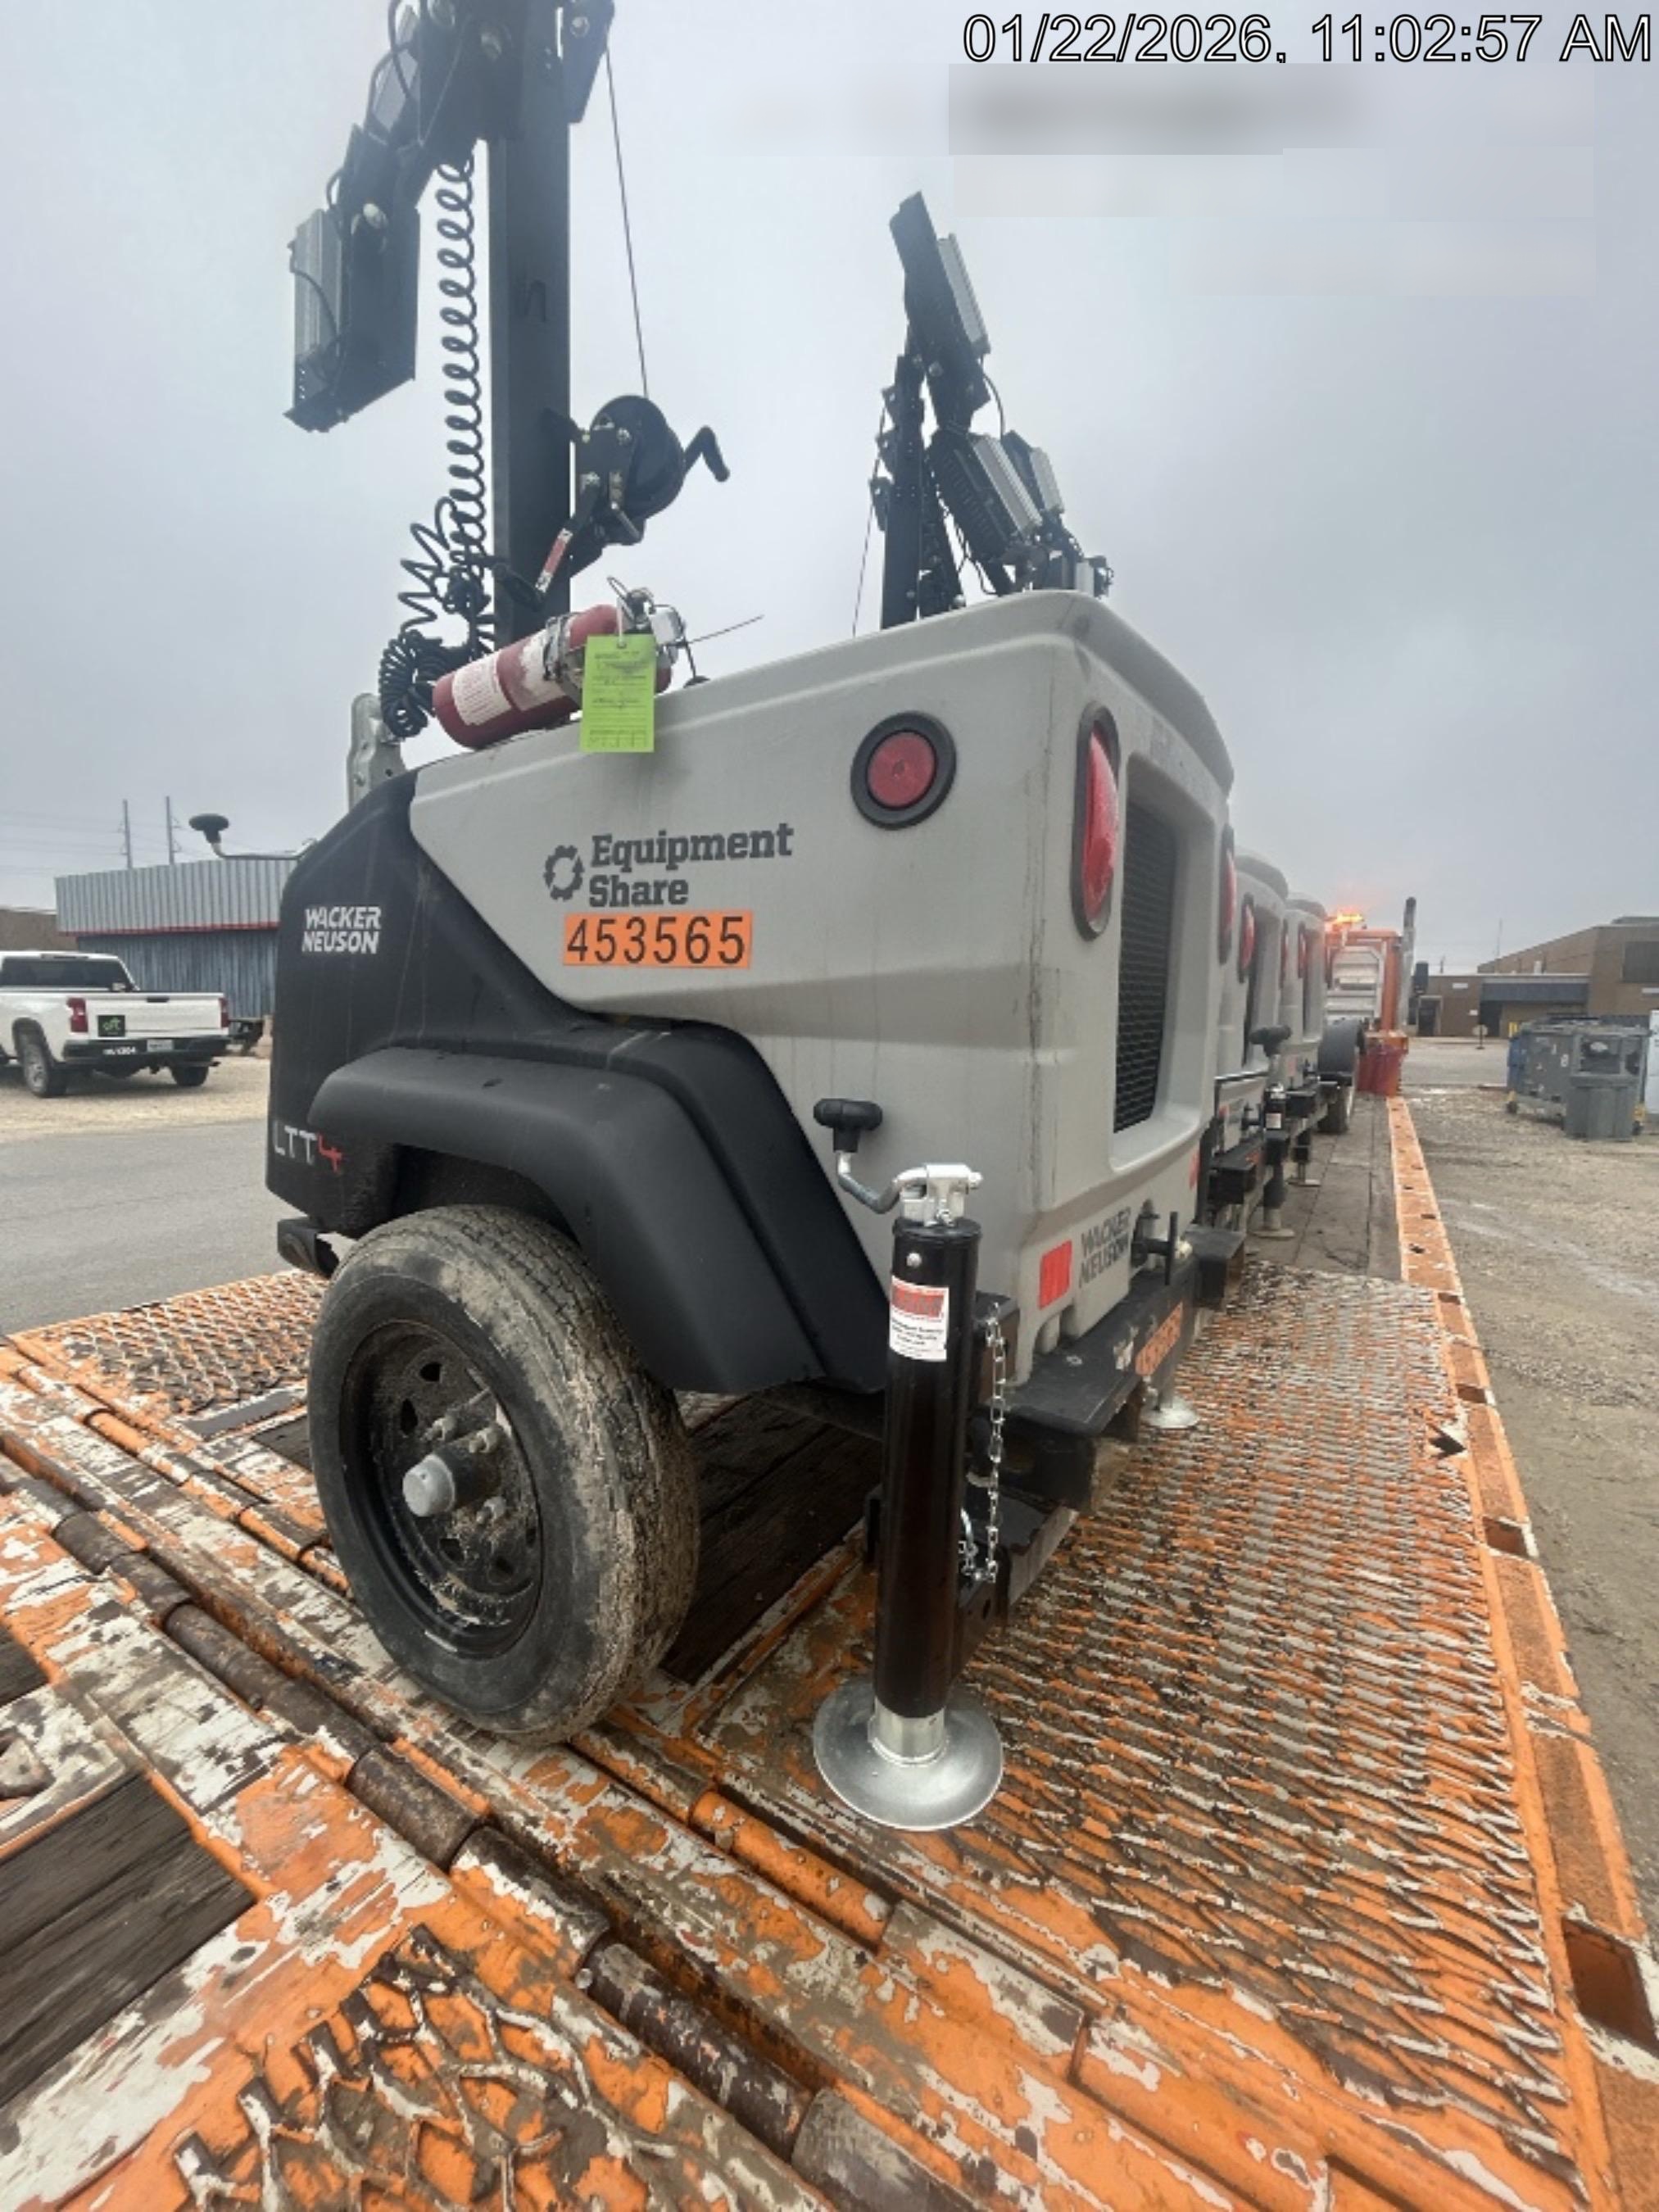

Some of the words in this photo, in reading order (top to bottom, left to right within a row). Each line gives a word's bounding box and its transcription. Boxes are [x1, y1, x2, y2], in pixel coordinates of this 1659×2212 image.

[591, 823, 794, 873] Equipment
[589, 874, 688, 908] Share
[305, 905, 382, 930] WACKER
[301, 930, 379, 954] NEUSON
[567, 916, 745, 964] 453565
[273, 1120, 342, 1173] LTT4
